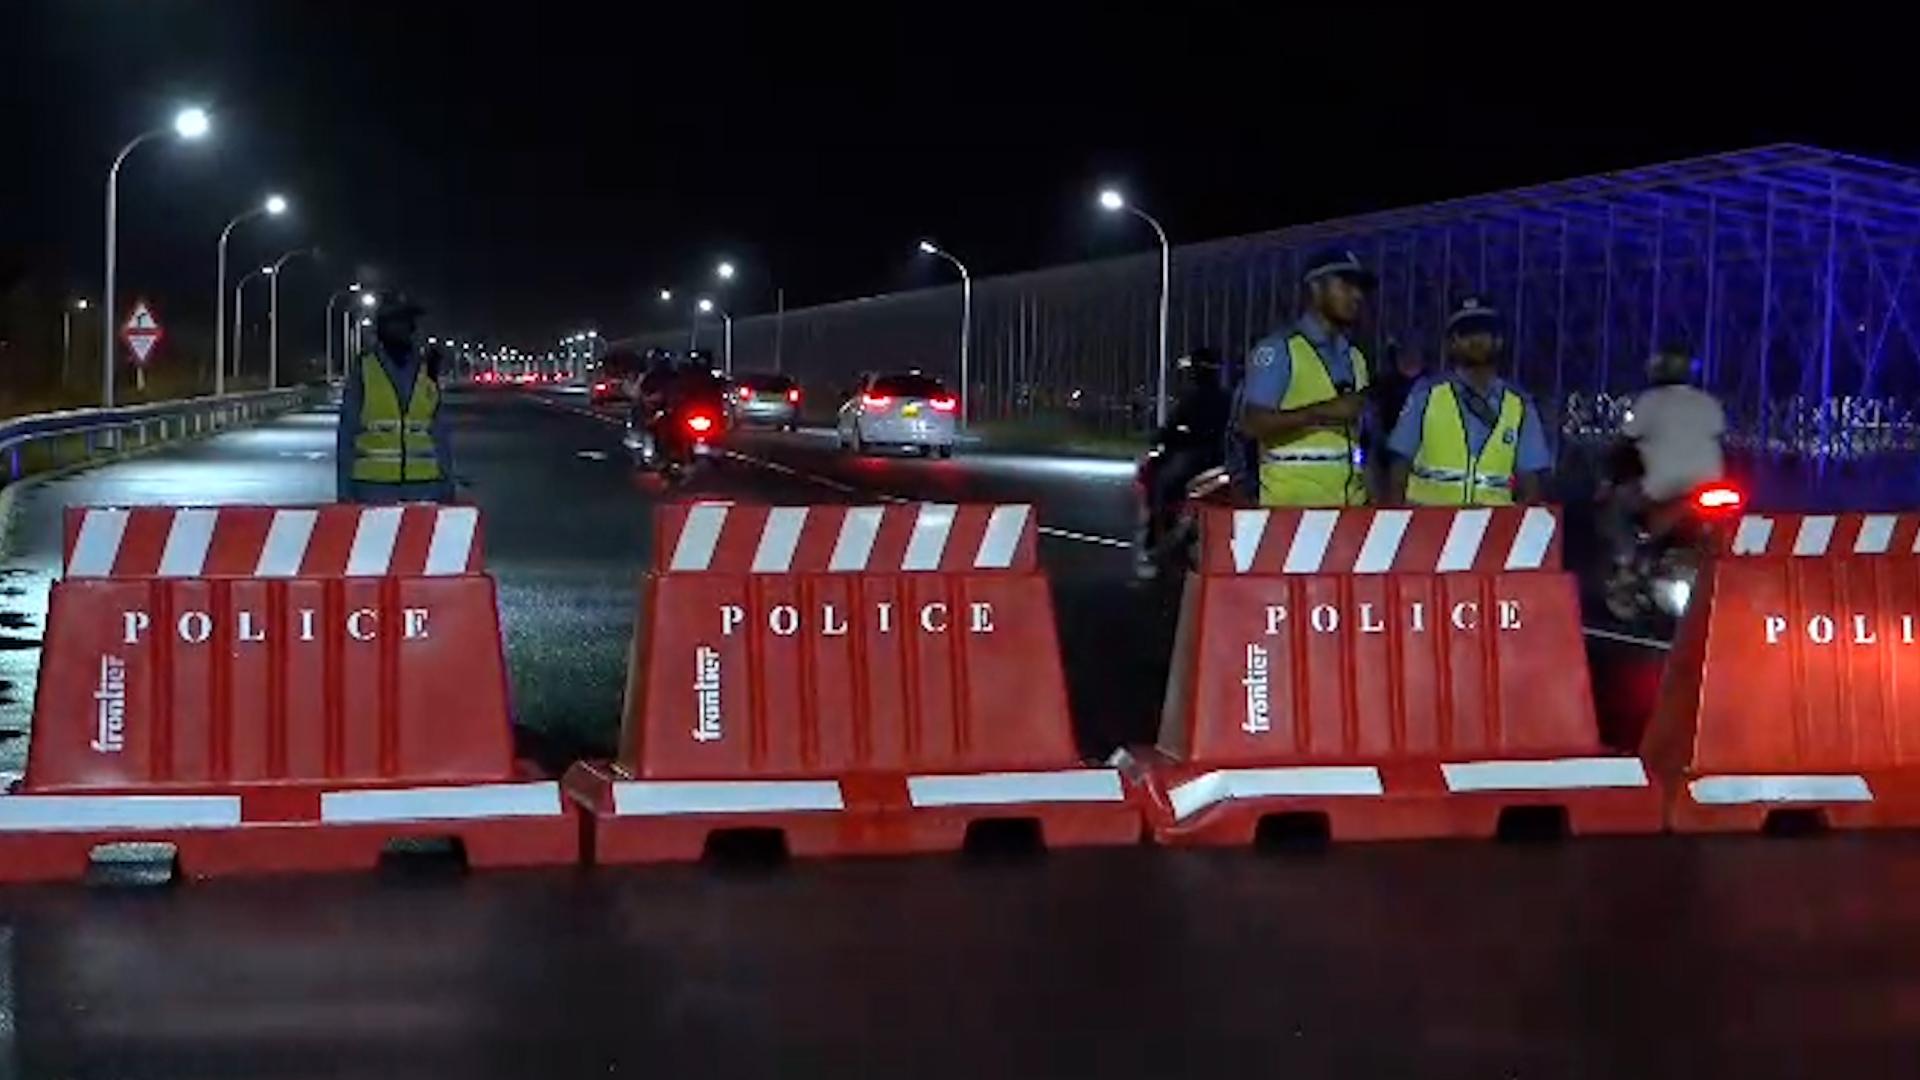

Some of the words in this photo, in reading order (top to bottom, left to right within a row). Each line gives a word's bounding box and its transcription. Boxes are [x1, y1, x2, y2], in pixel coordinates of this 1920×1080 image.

[123, 608, 429, 643] POLICE
[720, 603, 994, 635] POLICE
[1264, 601, 1521, 635] POLICE
[1764, 614, 1915, 644] POLI
[91, 654, 125, 752] frontier
[692, 646, 721, 742] frontier
[1241, 643, 1270, 734] frontier
